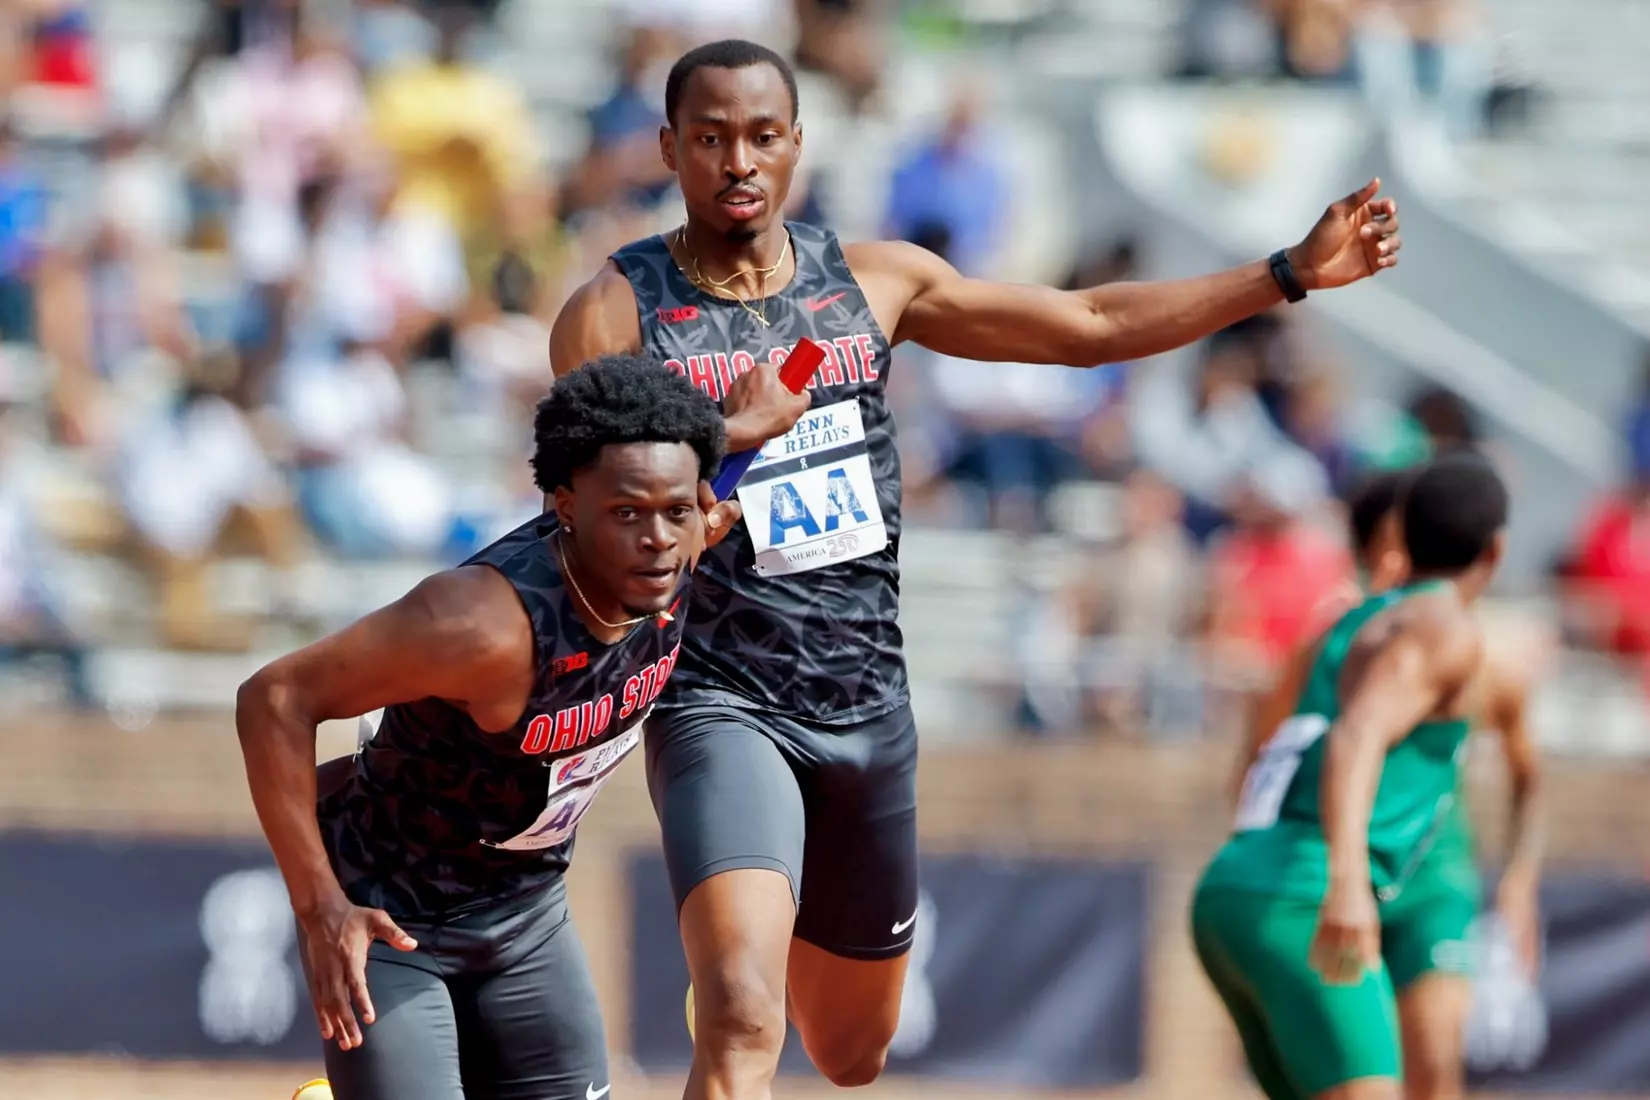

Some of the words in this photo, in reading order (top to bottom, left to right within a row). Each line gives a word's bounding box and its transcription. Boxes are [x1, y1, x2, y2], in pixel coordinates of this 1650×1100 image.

[768, 334, 878, 389] ATE
[784, 413, 833, 438] ENN
[785, 425, 850, 454] RELAYS
[769, 468, 869, 546] AA
[786, 547, 826, 563] AMERICA
[826, 534, 859, 558] 250
[520, 693, 613, 754] OHIO
